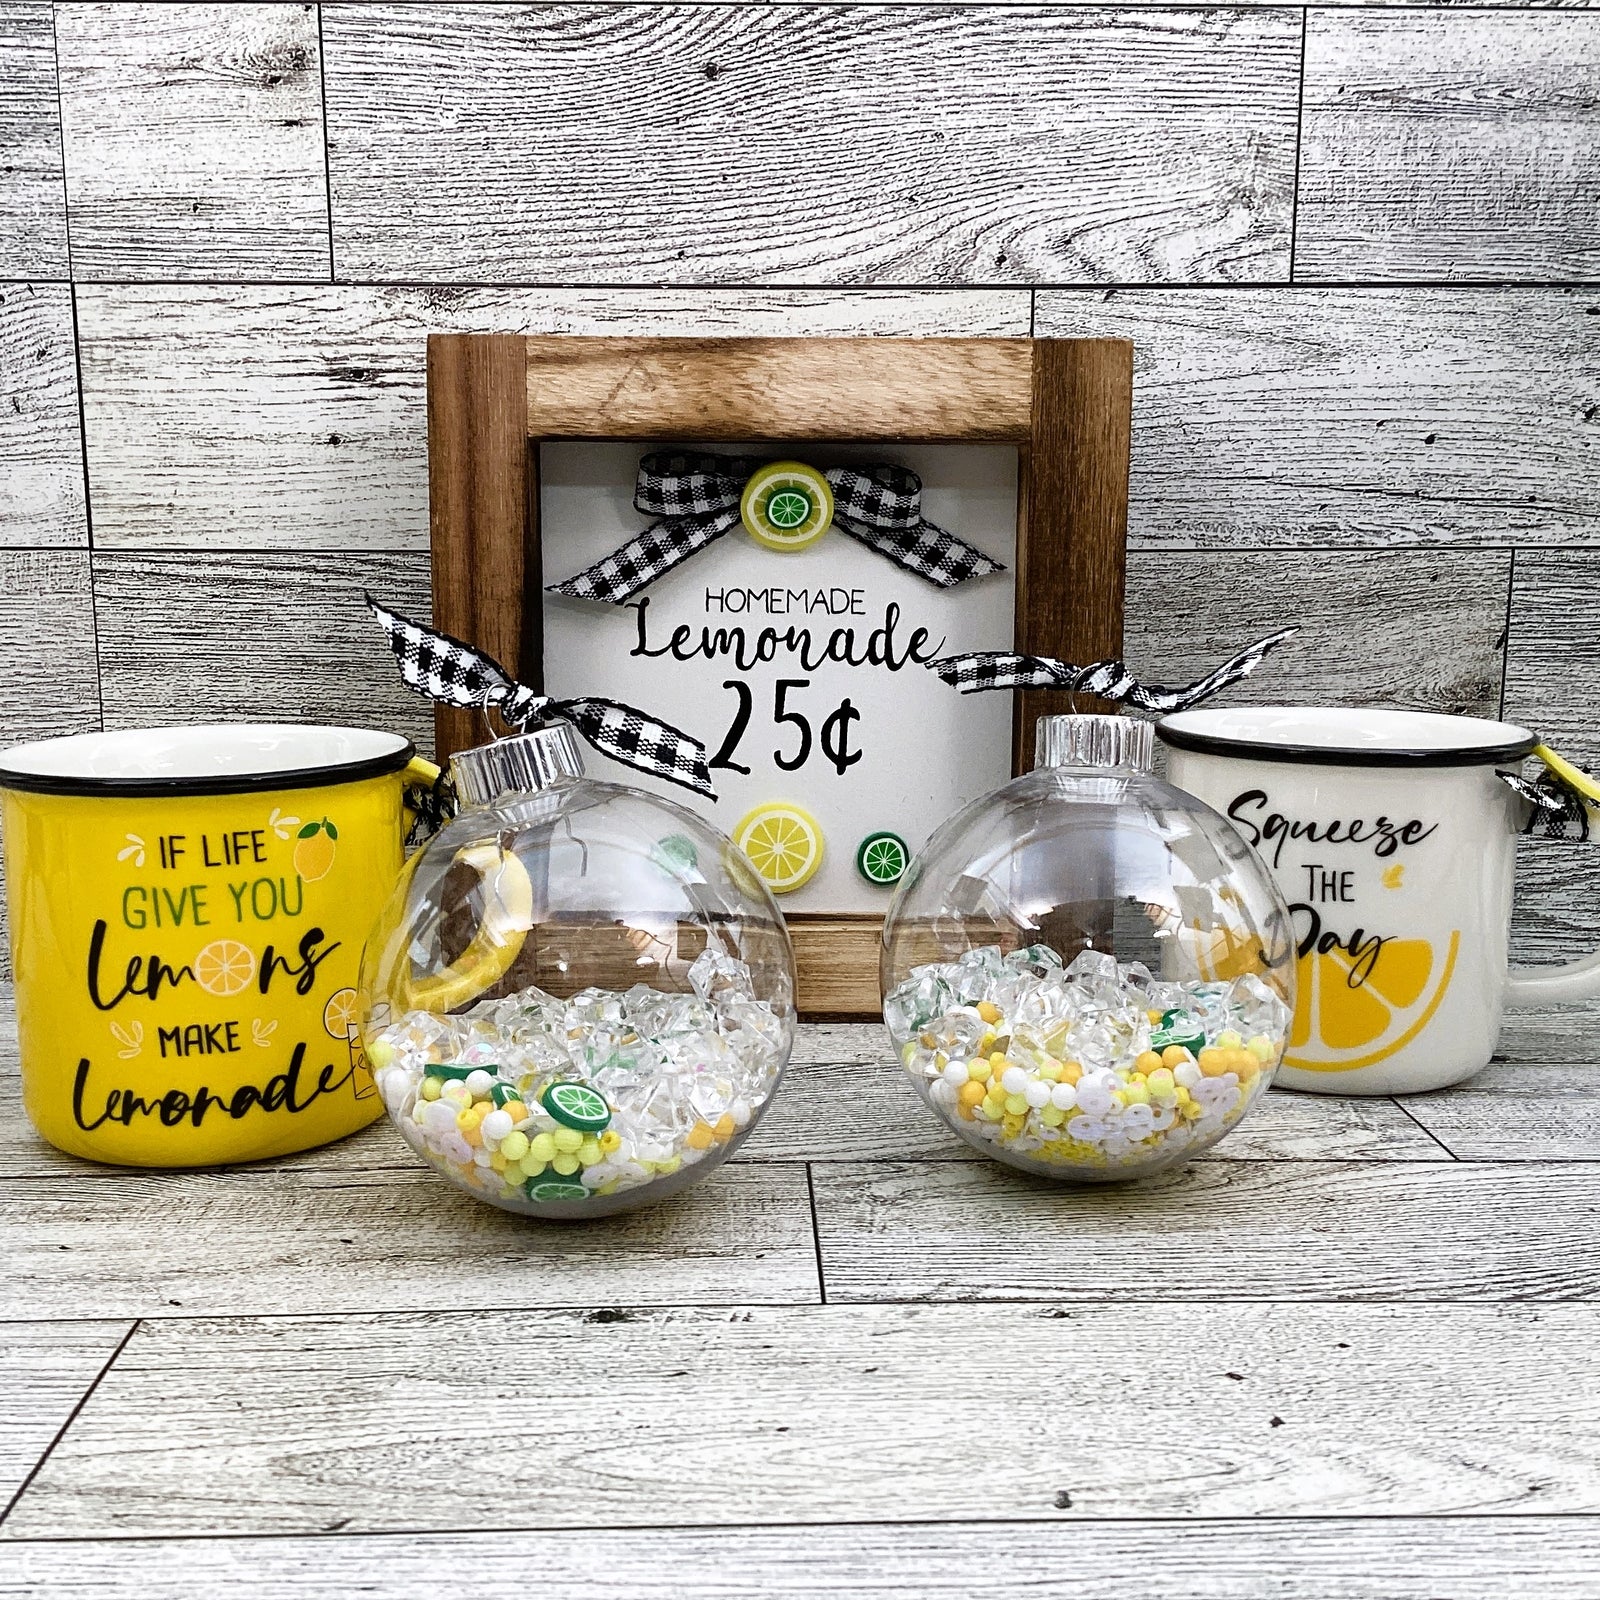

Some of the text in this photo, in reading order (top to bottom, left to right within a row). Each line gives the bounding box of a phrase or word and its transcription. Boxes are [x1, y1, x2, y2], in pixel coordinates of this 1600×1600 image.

[705, 587, 867, 616] HOMEMADE
[623, 596, 947, 672] Lemonade
[708, 678, 863, 776] 25¢
[159, 829, 268, 869] IF LIFE
[1226, 789, 1439, 869] Squeeze
[122, 875, 304, 930] GIVE YOU
[1301, 864, 1355, 903] THE
[1258, 903, 1398, 989] Day
[158, 1020, 241, 1059] MAKE
